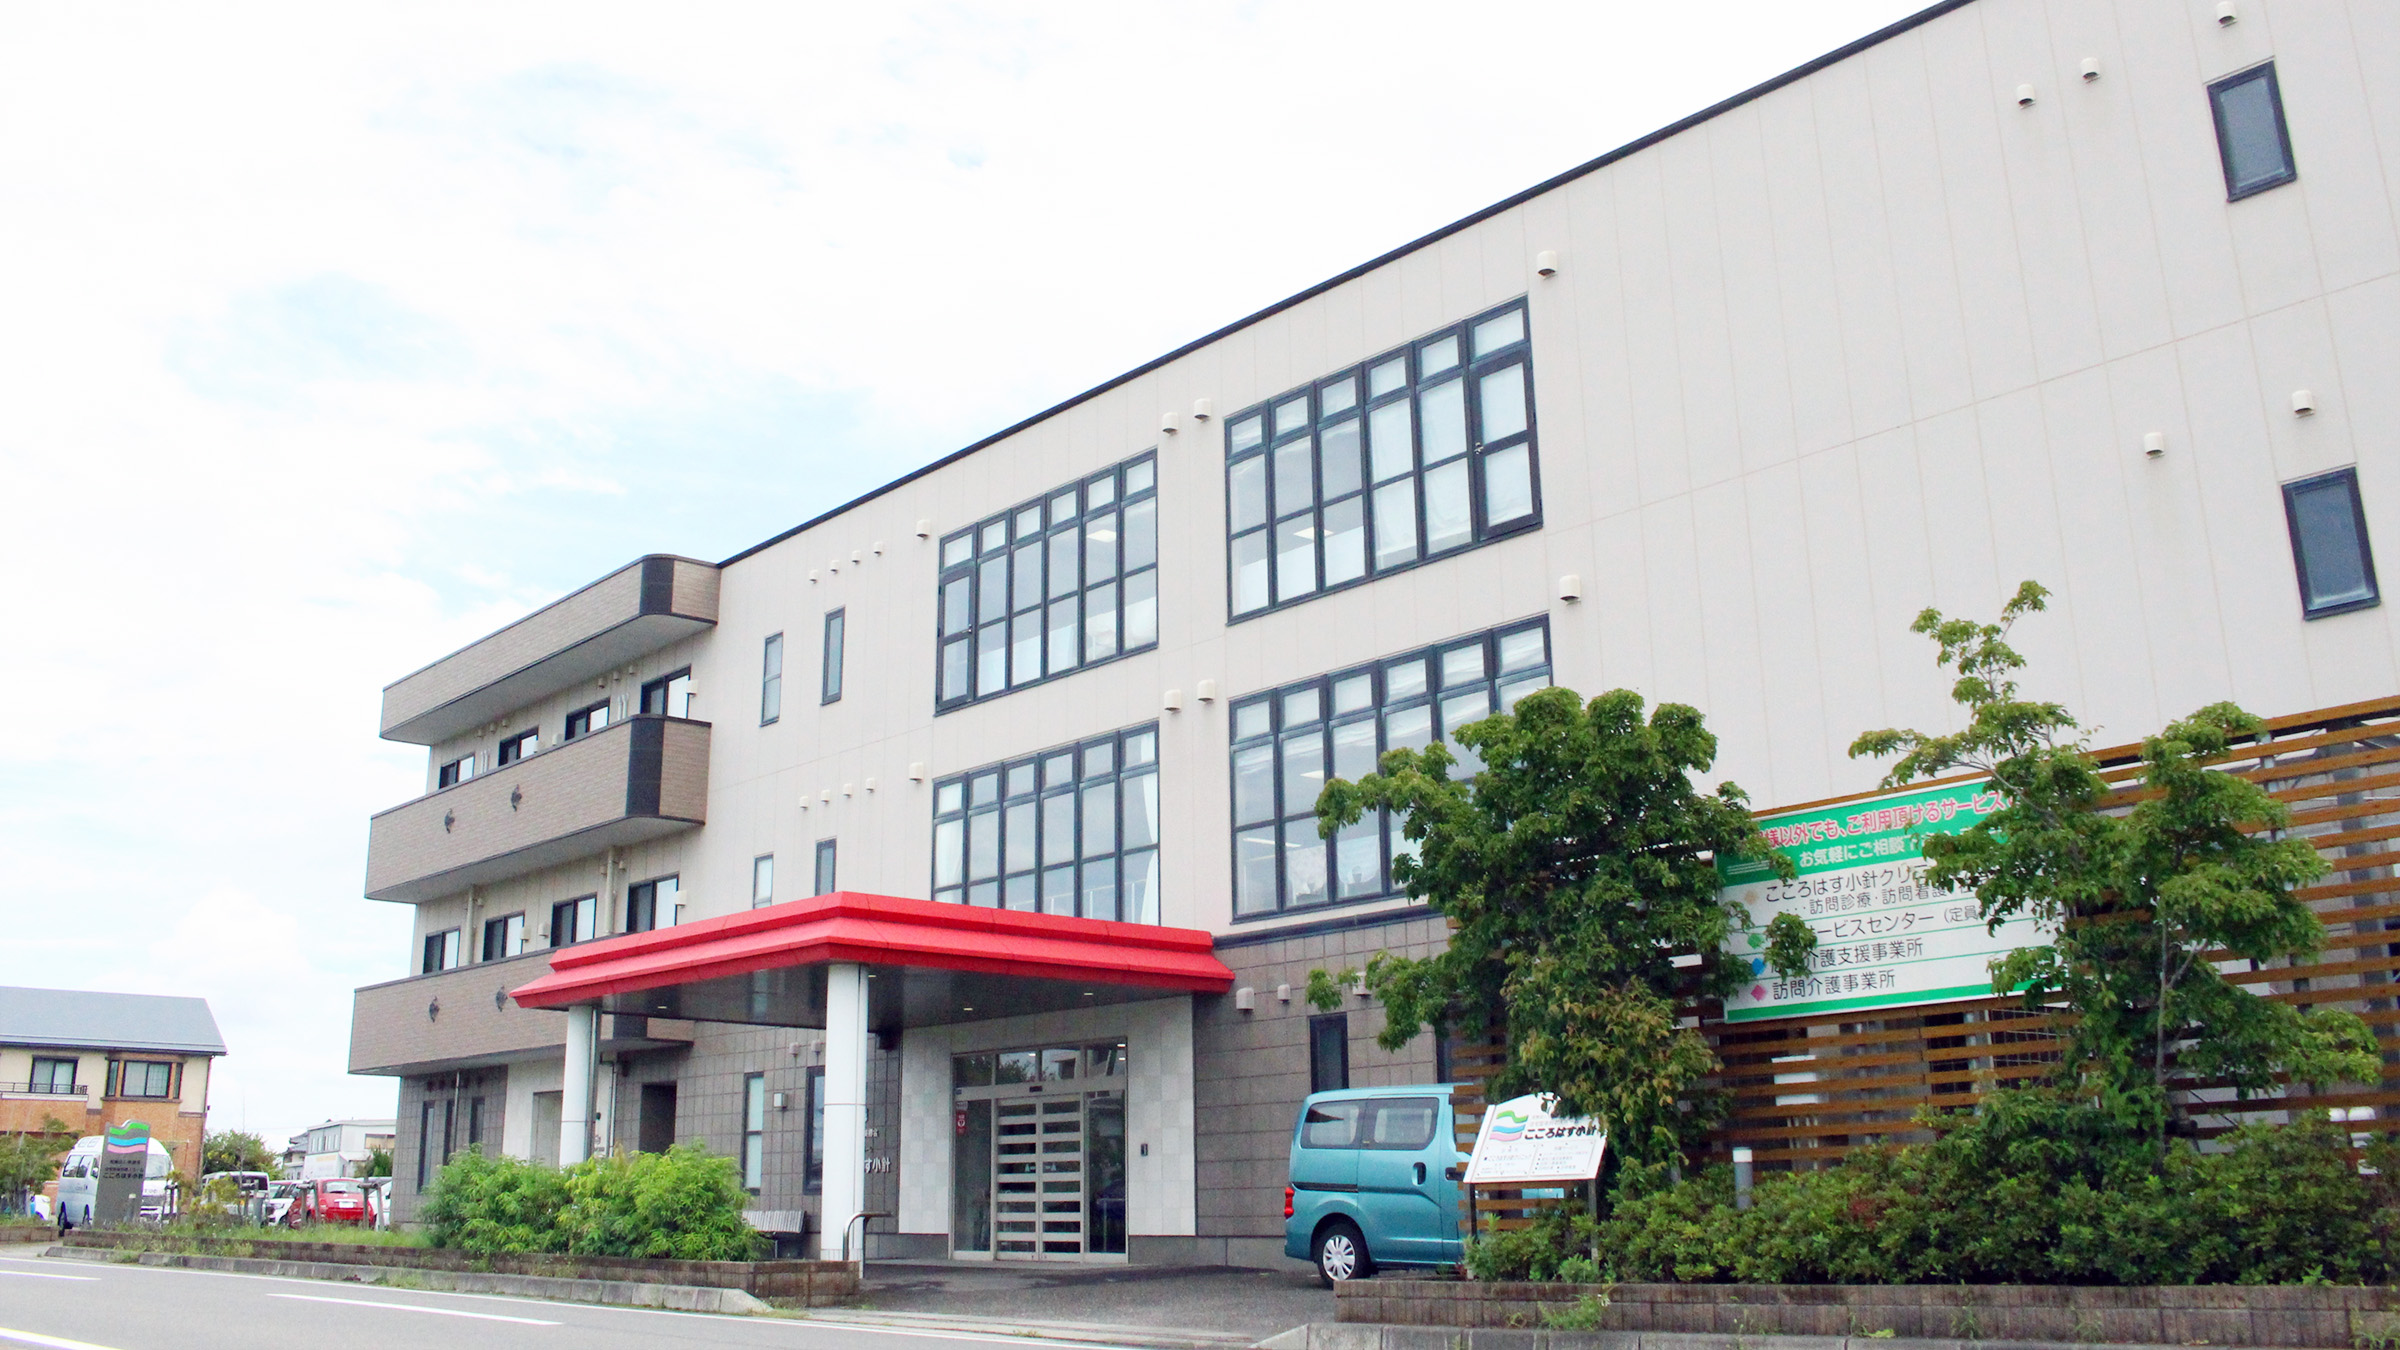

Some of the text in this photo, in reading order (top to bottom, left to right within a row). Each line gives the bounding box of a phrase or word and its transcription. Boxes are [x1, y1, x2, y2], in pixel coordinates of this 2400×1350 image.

[1760, 790, 2013, 848] 様以外でも、ご利用頂けるサービス
[1810, 911, 1935, 938] ービスセンター
[1771, 937, 1923, 974] 介護支援事業所
[1772, 969, 1896, 1000] 訪問介護事業所
